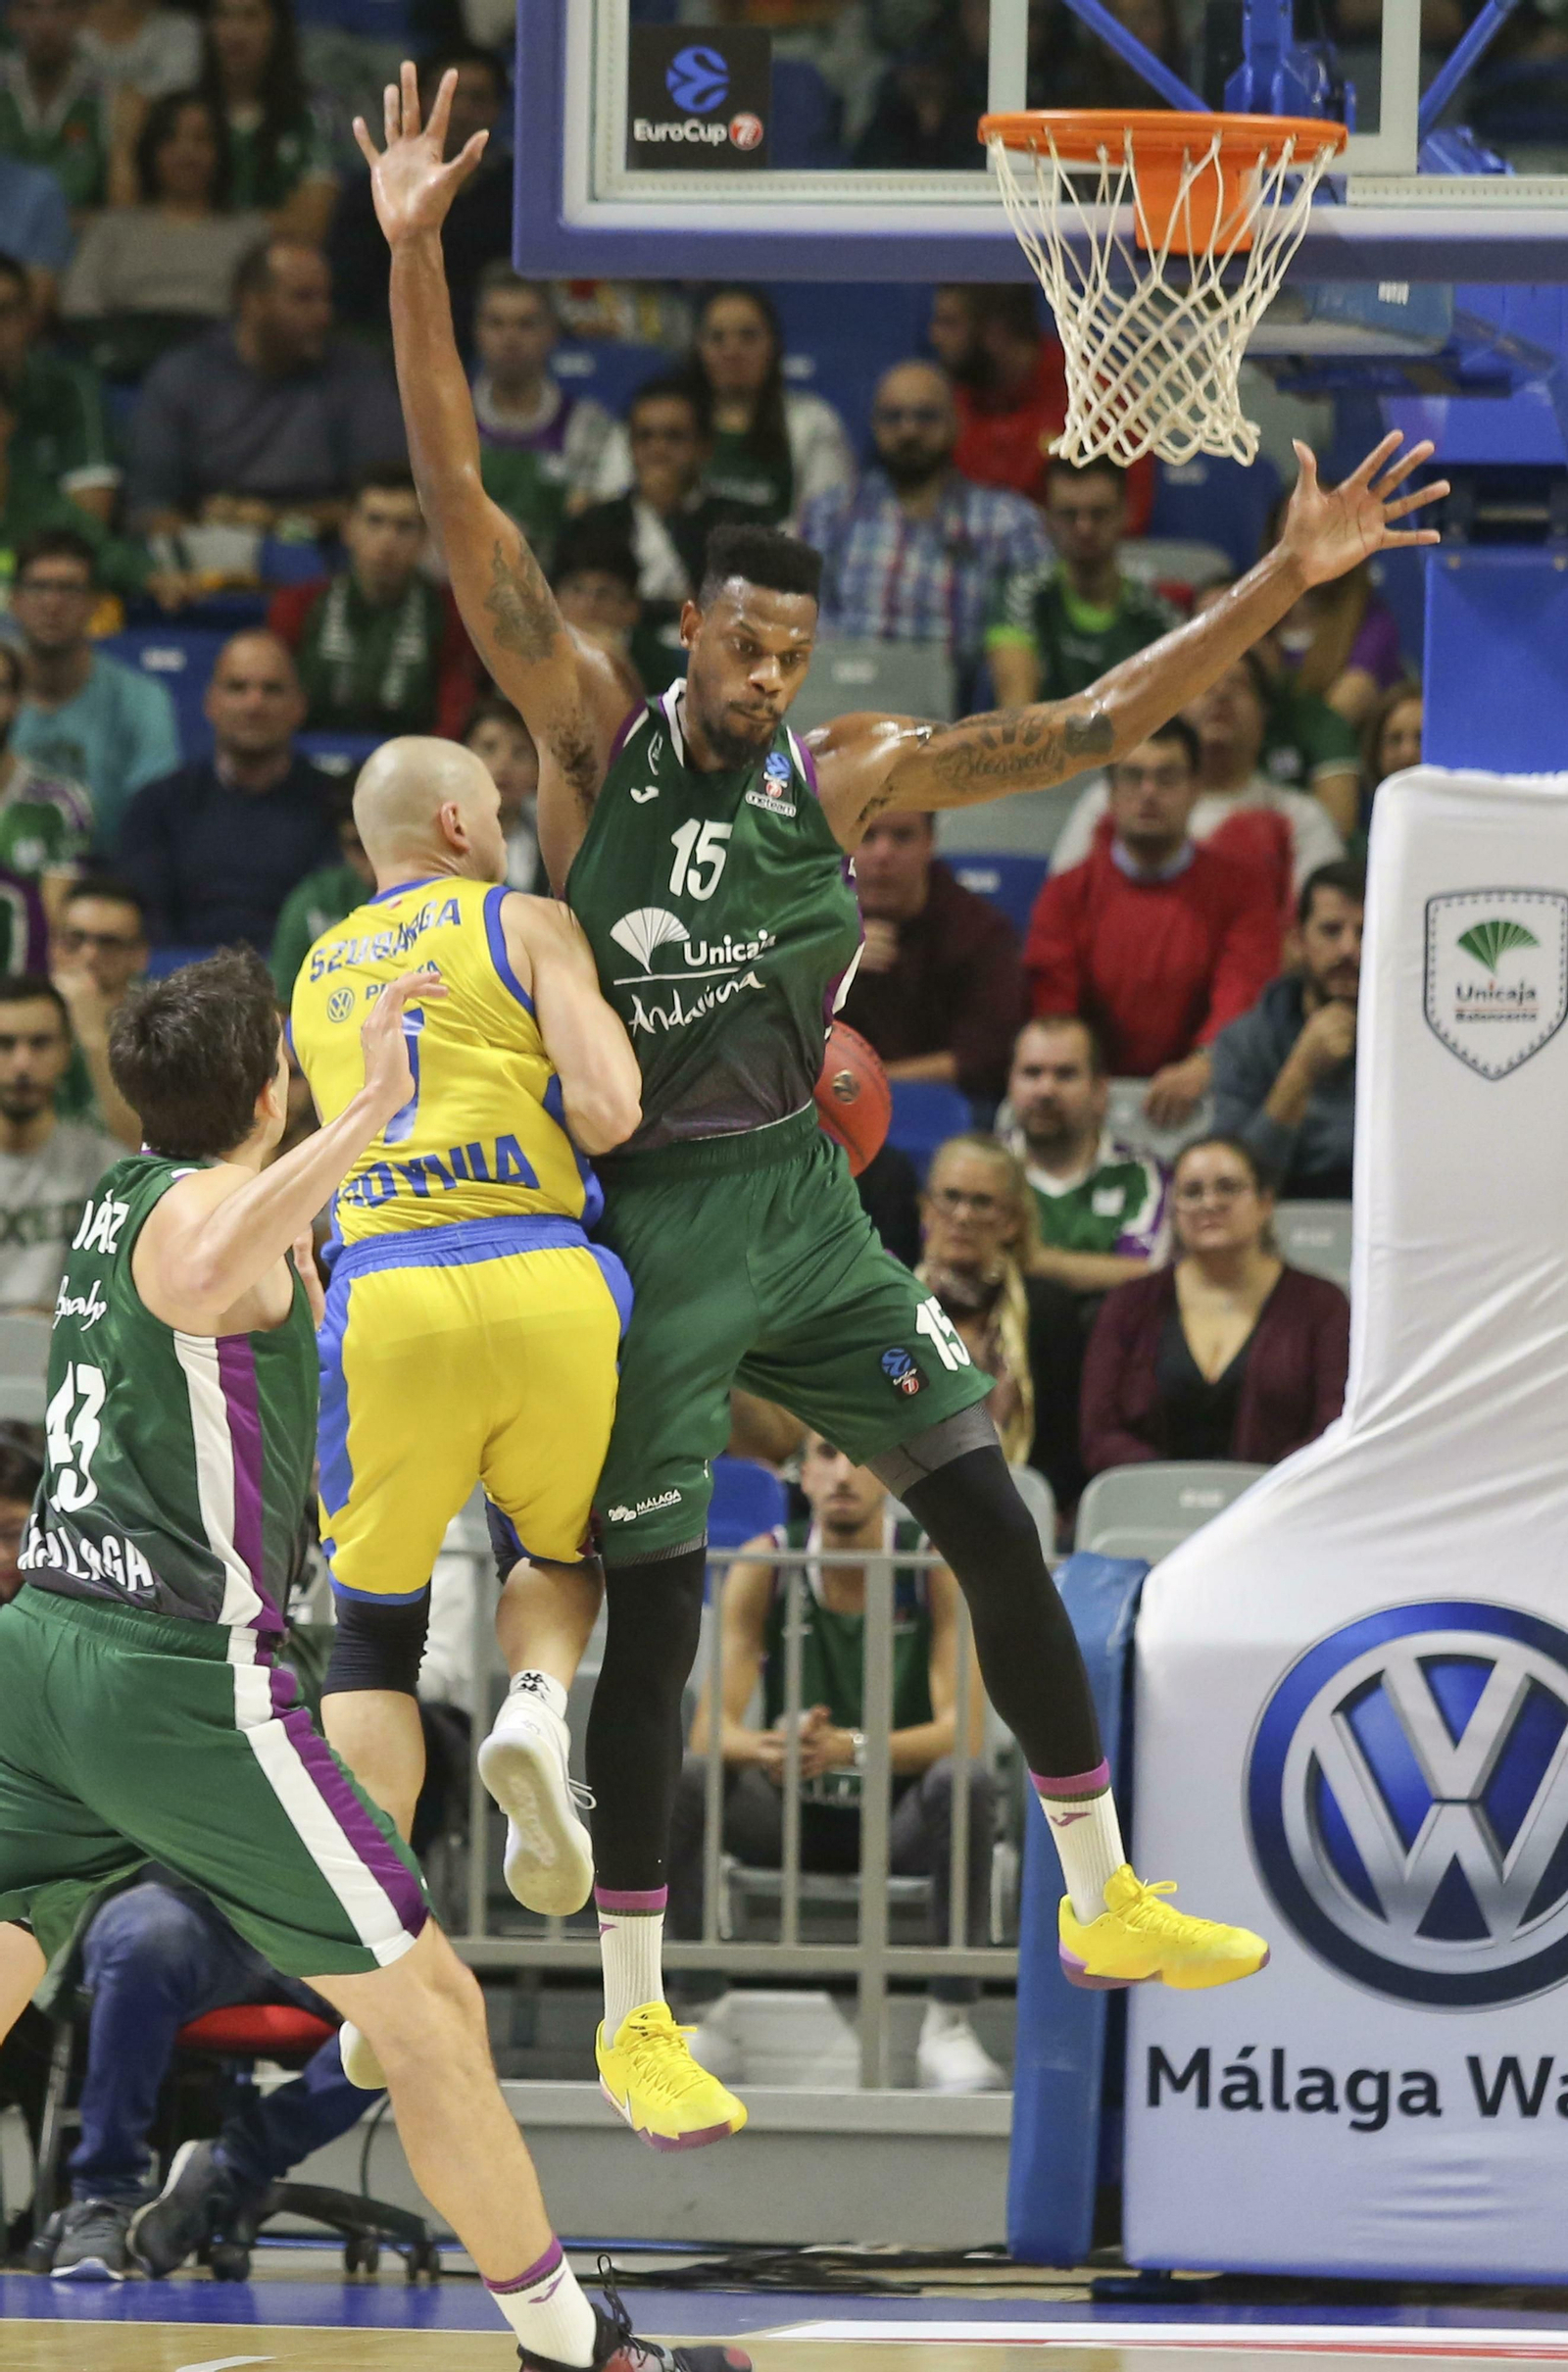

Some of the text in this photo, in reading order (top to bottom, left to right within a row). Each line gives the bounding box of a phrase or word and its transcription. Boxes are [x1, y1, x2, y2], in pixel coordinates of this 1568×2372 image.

[633, 118, 728, 146] EuroCup
[669, 817, 733, 901] 15
[1455, 980, 1537, 1006] Unicaja
[916, 1295, 971, 1371] 15
[1147, 2045, 1568, 2133] Málaga W
